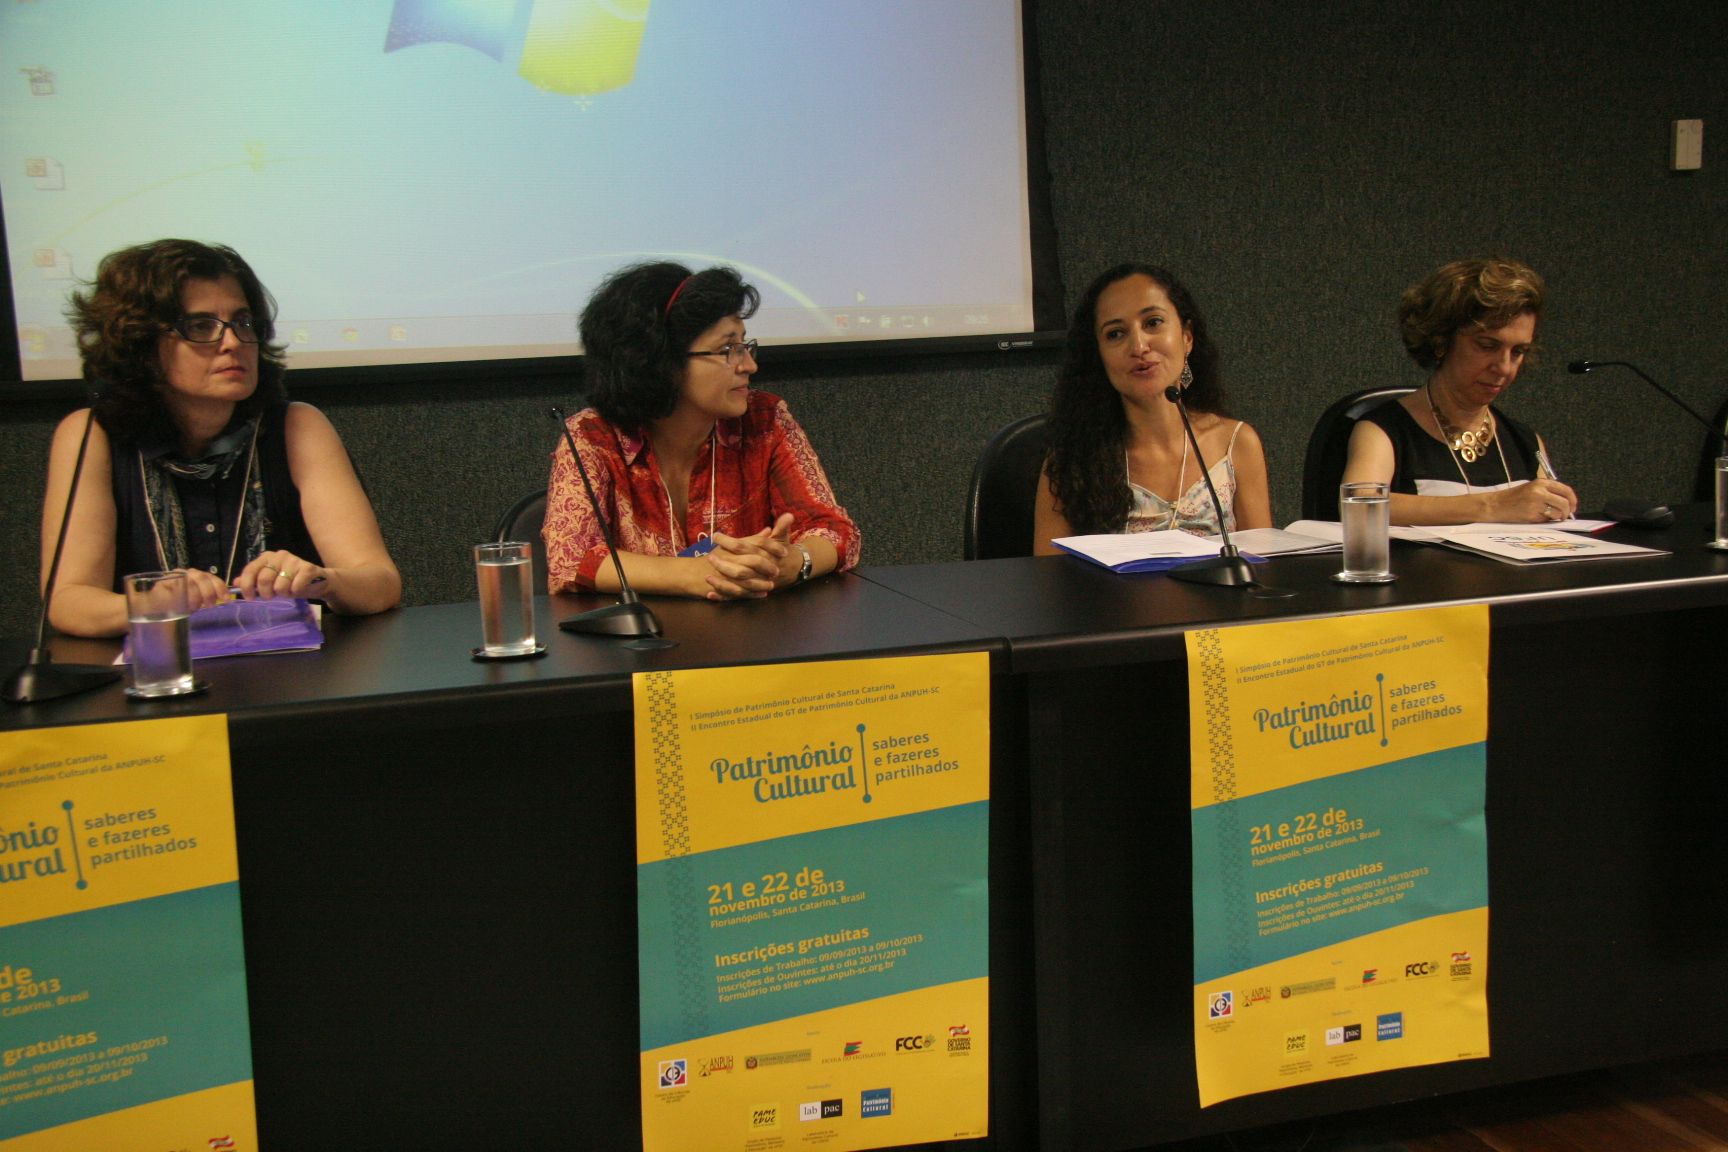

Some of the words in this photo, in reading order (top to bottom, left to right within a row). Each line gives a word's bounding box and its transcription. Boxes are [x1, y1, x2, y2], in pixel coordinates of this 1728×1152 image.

[1240, 662, 1270, 673] Simpósio
[1322, 646, 1348, 656] Cultural
[1360, 641, 1378, 649] Santa
[1380, 635, 1408, 644] Catarina
[1244, 672, 1274, 682] Encontro
[1276, 665, 1305, 676] Estadual
[1375, 646, 1400, 656] Cultural
[1412, 636, 1444, 648] ANPUH-SC
[694, 709, 732, 720] Simpósio
[746, 700, 790, 712] Patrimônio
[792, 692, 824, 704] Cultural
[838, 688, 860, 698] Santa
[862, 684, 896, 694] Catarina
[1390, 680, 1436, 698] saberes
[1391, 703, 1398, 712] e
[1401, 692, 1445, 710] fazeres
[698, 718, 735, 730] Encontro
[738, 713, 771, 724] Estadual
[810, 699, 854, 712] Patrimônio
[856, 694, 886, 705] Cultural
[900, 687, 940, 698] ANPUH-SC
[1253, 690, 1373, 732] Patrimônio
[1392, 704, 1462, 730] partilhados
[873, 733, 930, 750] saberes
[1289, 712, 1376, 749] Cultural
[18, 766, 31, 774] de
[34, 760, 63, 772] Santa
[65, 754, 108, 766] Catarina
[58, 766, 98, 780] Cultural
[101, 764, 113, 772] da
[116, 754, 166, 770] ANPUH-SC
[710, 742, 853, 784] Patrimônio
[874, 756, 882, 766] e
[886, 747, 940, 764] fazeres
[754, 766, 856, 802] Cultural
[876, 758, 959, 786] partilhados
[84, 808, 157, 830] saberes
[1250, 824, 1272, 844] 21
[1278, 822, 1290, 836] e
[1294, 813, 1318, 834] 22
[1322, 808, 1347, 826] de
[88, 837, 98, 848] e
[104, 824, 171, 846] fazeres
[1251, 832, 1314, 856] novembro
[1317, 827, 1332, 839] de
[1335, 818, 1364, 834] 2013
[1303, 844, 1324, 854] Santa
[1360, 828, 1380, 840] Brasil
[91, 836, 198, 870] partilhados
[708, 882, 733, 904] 21
[742, 882, 756, 897] e
[762, 872, 790, 894] 22
[796, 867, 824, 887] de
[1256, 878, 1322, 904] Inscrições
[1324, 862, 1384, 888] gratuitas
[710, 894, 786, 916] novembro
[789, 888, 808, 900] de
[811, 880, 845, 897] 2013
[710, 911, 770, 928] Florianópolis,
[772, 906, 798, 917] Santa
[800, 899, 838, 912] Catarina,
[841, 892, 866, 904] Brasil
[1258, 904, 1294, 918] Inscrições
[715, 943, 794, 967] Inscrições
[798, 928, 870, 954] gratuitas
[716, 968, 760, 982] Inscrições
[763, 965, 774, 974] de
[776, 956, 817, 970] Trabalho:
[819, 945, 866, 962] 09/09/2013
[876, 934, 924, 950] 09/10/2013
[0, 966, 33, 990] de
[718, 979, 762, 993] Inscrições
[764, 976, 775, 984] de
[777, 968, 818, 981] Ouvintes:
[820, 962, 834, 972] até
[844, 959, 858, 968] dia
[860, 948, 906, 964] 20/11/2013
[719, 986, 768, 1003] Formulário
[784, 980, 801, 990] site:
[804, 961, 894, 985] www.anpuh-sc.org.br
[1406, 962, 1428, 977] FCC
[16, 978, 62, 1000] 2013
[56, 990, 89, 1005] Brasil
[896, 1036, 922, 1052] FCC
[1329, 1030, 1340, 1040] lab
[1346, 1029, 1360, 1040] pac
[3, 1032, 98, 1067] gratuitas
[710, 1056, 734, 1068] ANPUH
[852, 1052, 886, 1060] LEGISLATIVO
[67, 1069, 84, 1078] dia
[753, 1108, 776, 1118] PAME
[753, 1116, 776, 1124] EDUC
[804, 1106, 818, 1116] lab
[824, 1104, 840, 1114] pac
[863, 1104, 888, 1112] Cultural
